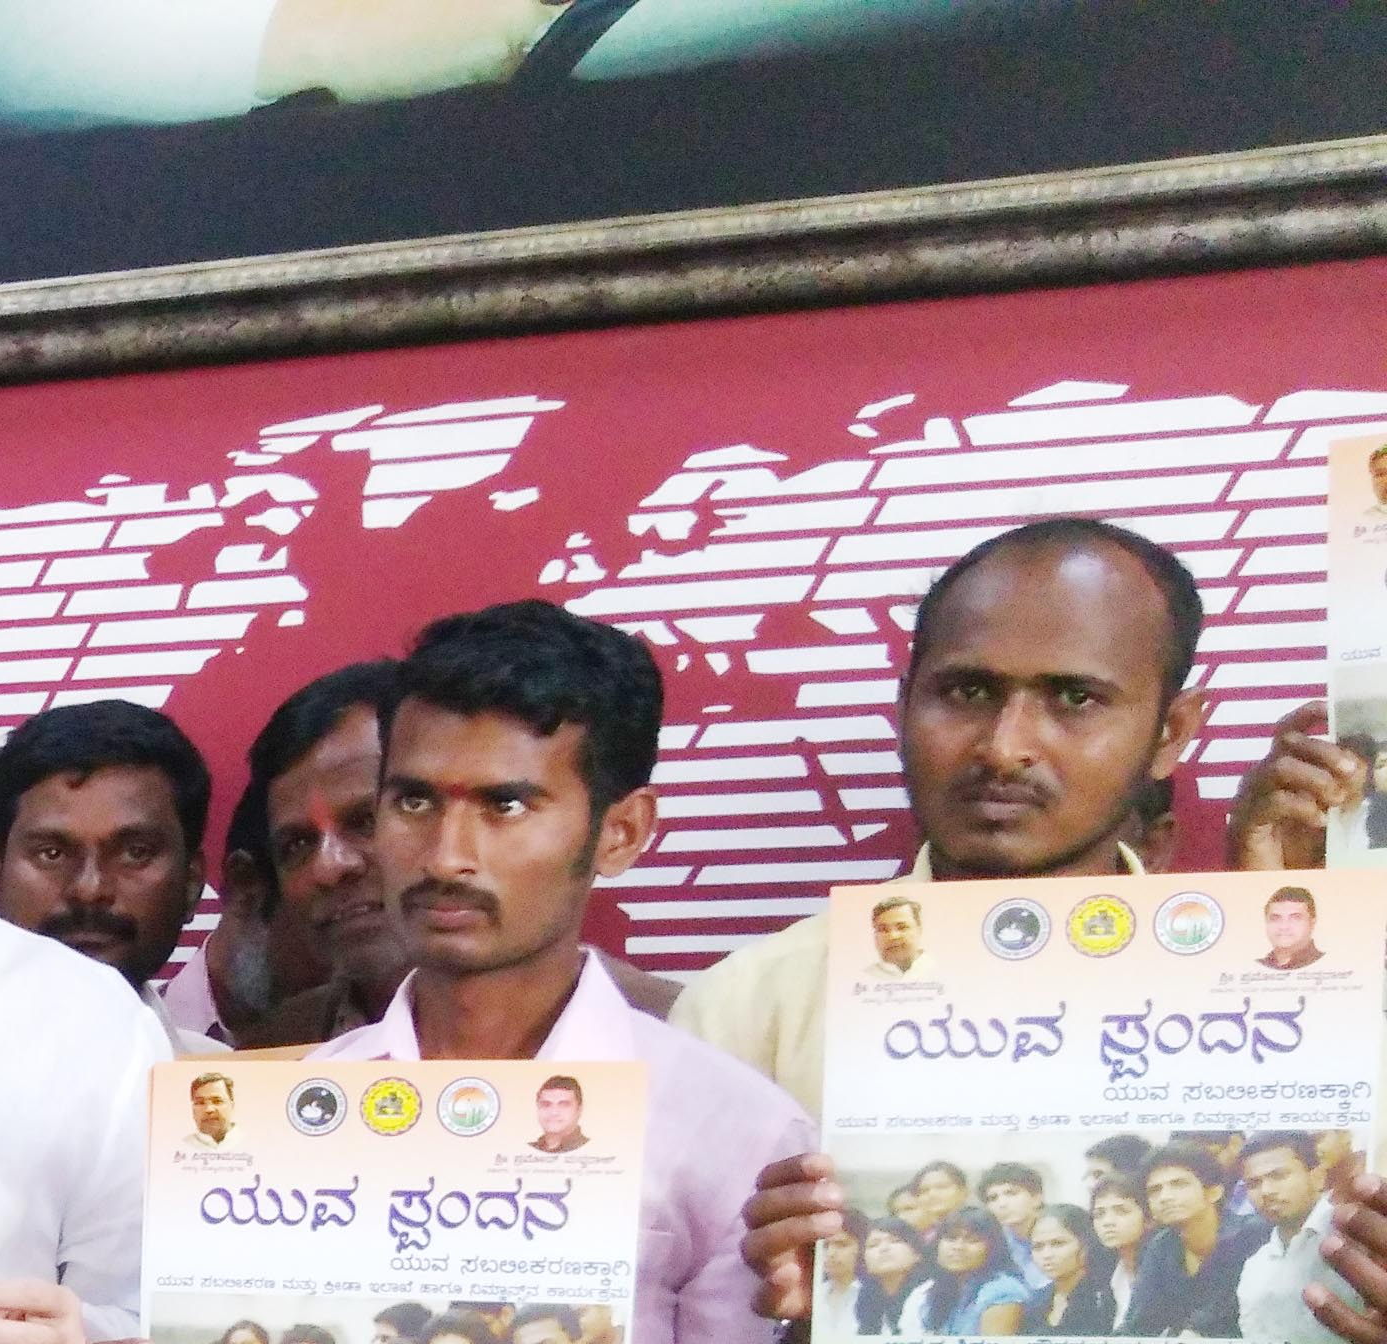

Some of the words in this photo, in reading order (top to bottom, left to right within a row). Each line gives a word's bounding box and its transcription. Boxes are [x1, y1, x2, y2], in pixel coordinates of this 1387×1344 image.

[885, 1001, 1065, 1062] ಯುವ
[1098, 994, 1307, 1082] ಸ್ಪಂದನ
[201, 1173, 358, 1231] ಯುವ
[387, 1177, 572, 1253] ಸ್ಪಂದನ
